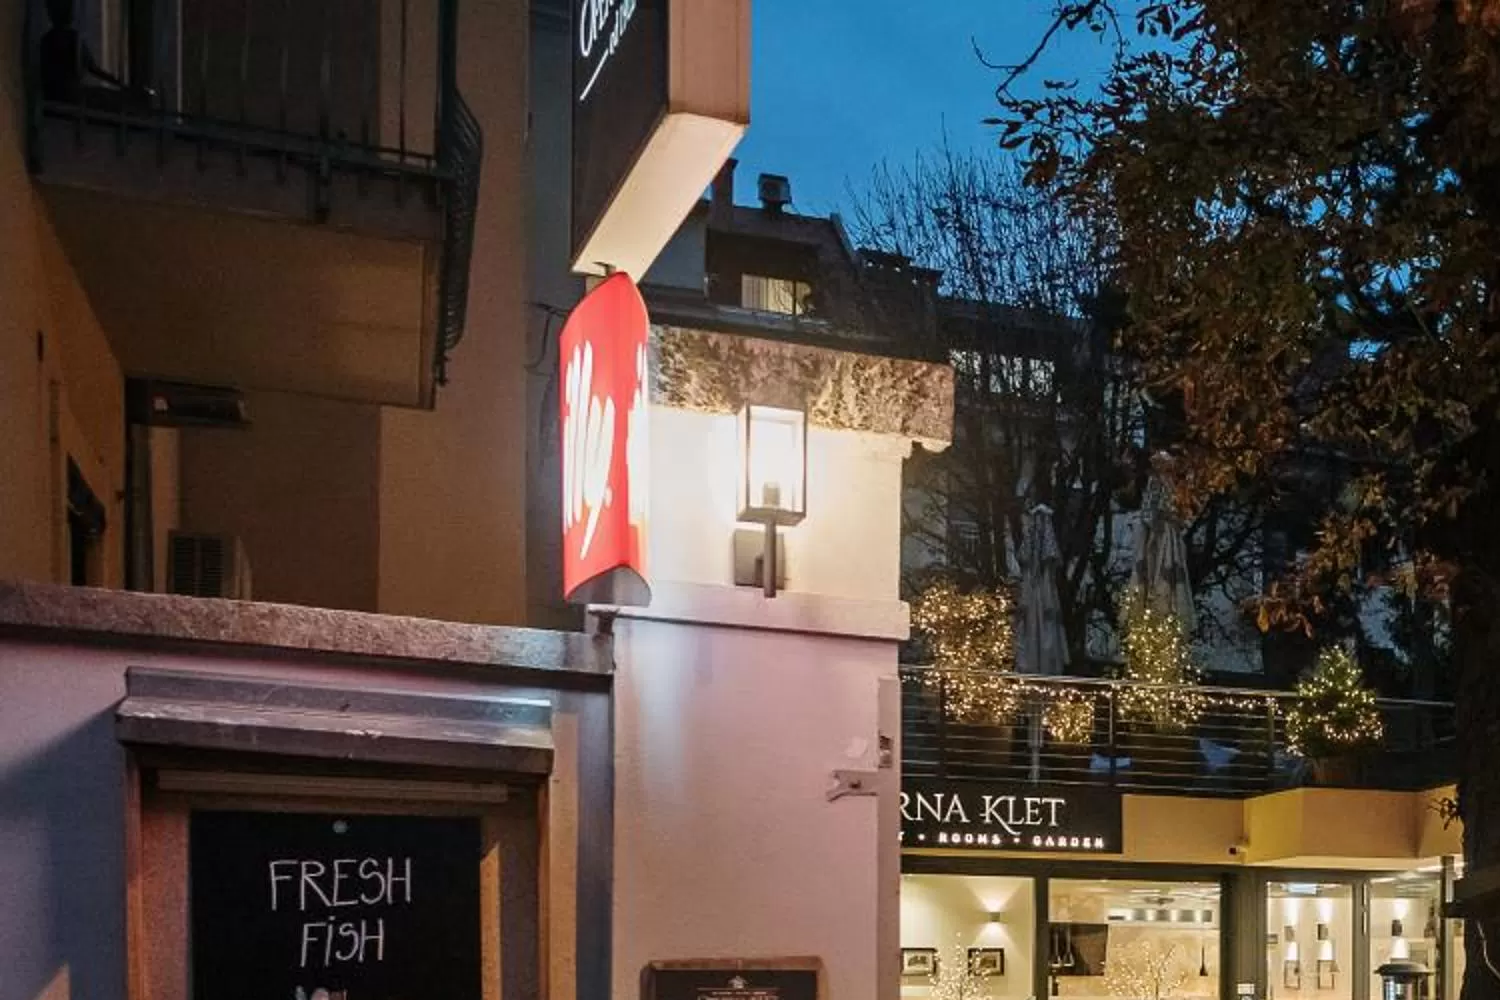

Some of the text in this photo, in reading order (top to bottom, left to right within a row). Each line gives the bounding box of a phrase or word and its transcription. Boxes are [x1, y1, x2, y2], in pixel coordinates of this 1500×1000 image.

[979, 795, 1066, 836] KLET
[938, 831, 1105, 849] ROOMS GARDEN
[269, 856, 412, 911] FRESH
